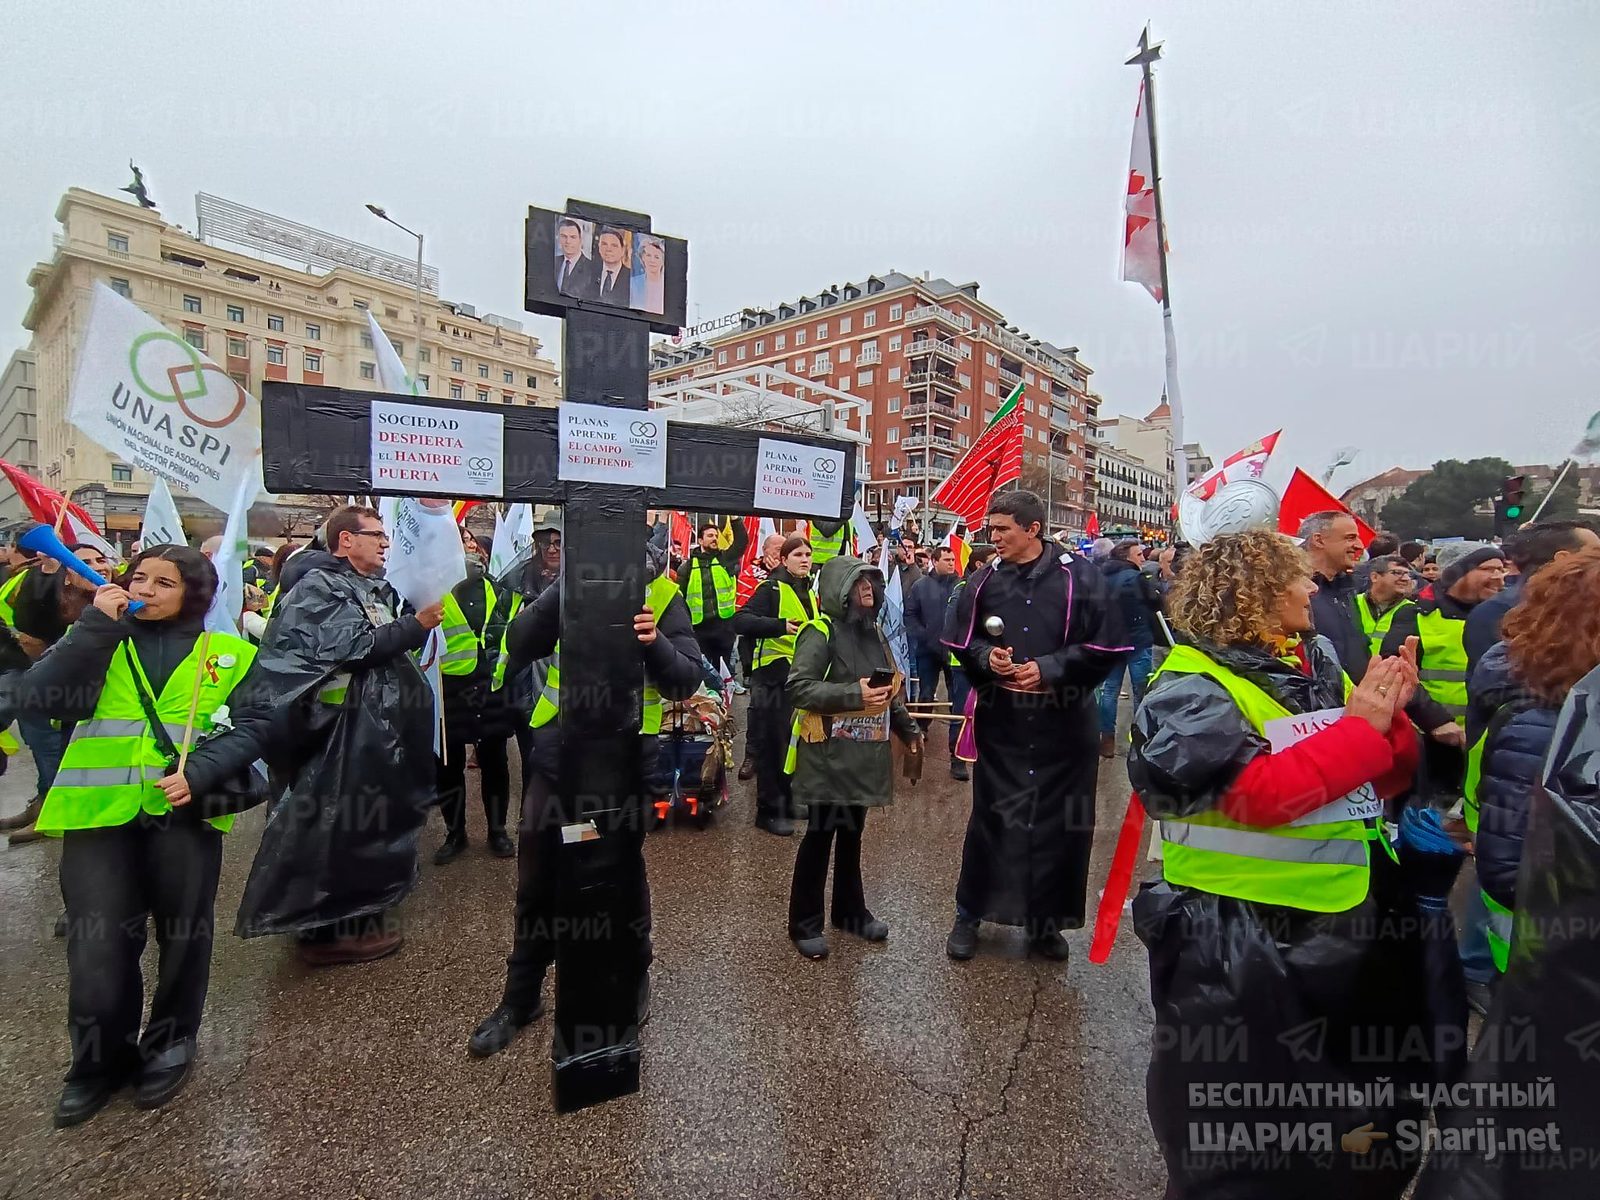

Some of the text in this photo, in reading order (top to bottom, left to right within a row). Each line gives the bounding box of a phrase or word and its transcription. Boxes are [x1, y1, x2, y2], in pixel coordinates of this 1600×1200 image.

[112, 381, 231, 466] UNASPI
[378, 412, 459, 430] SOCIEDAD
[568, 415, 609, 428] PLANAS
[127, 425, 163, 453] NACIONAL
[164, 445, 175, 456] DE
[378, 431, 464, 448] DESPIERTA
[568, 429, 618, 441] APRENDE
[629, 437, 658, 446] UNASPI
[568, 441, 582, 450] EL
[584, 442, 622, 455] CAMPO
[378, 450, 462, 466] EL HAMBRE
[567, 454, 634, 468] SE DEFIENDE
[765, 450, 798, 463] PLANAS
[140, 446, 169, 468] SECTOR
[168, 457, 200, 484] PRIMARIO
[764, 463, 803, 475] APRENDE
[379, 467, 440, 482] PUERTA
[467, 470, 494, 478] UNASPI
[763, 474, 775, 483] EL
[775, 475, 807, 487] CAMPO
[811, 471, 837, 481] UNASPI
[762, 486, 816, 500] SE DEFIENDE
[1291, 716, 1332, 737] MÁS
